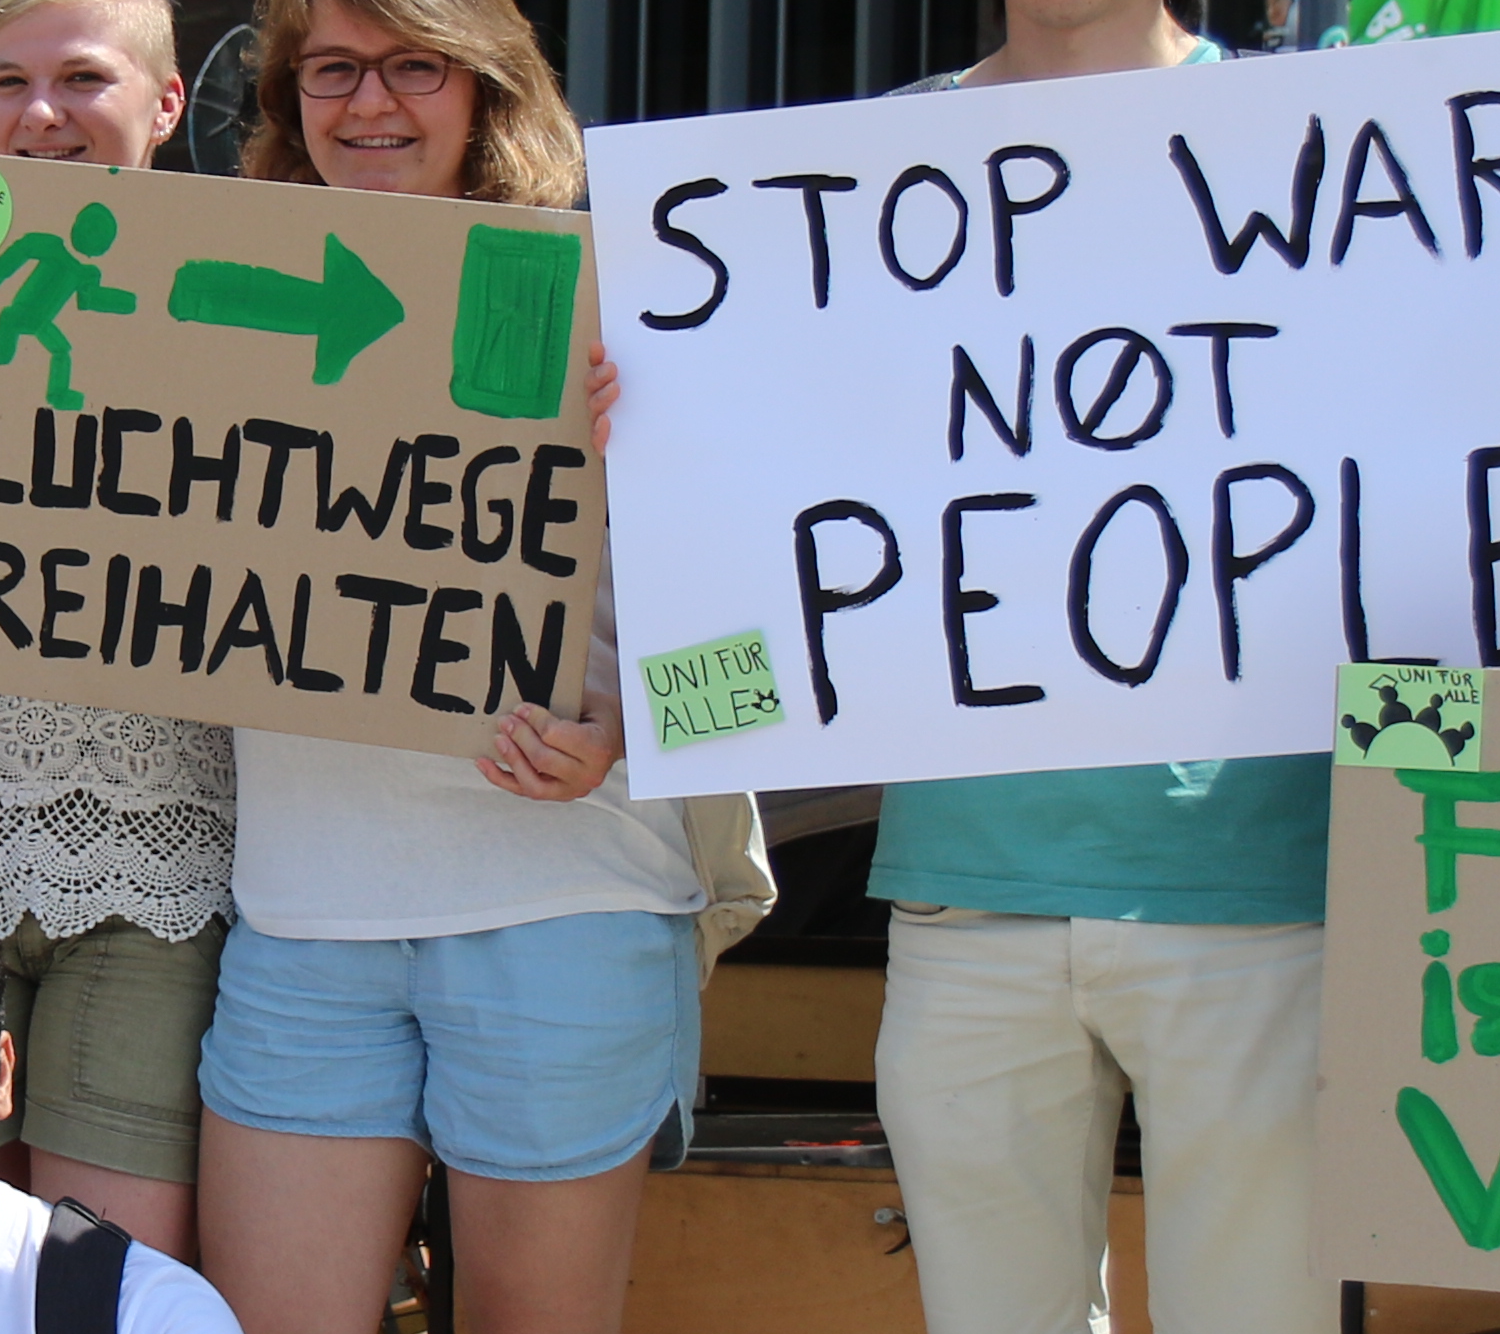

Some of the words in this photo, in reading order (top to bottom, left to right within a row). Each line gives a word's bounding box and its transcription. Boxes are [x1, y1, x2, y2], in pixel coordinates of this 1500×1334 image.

[640, 143, 1071, 330] STOP
[647, 654, 708, 697] UNI
[714, 642, 769, 680] FÜR
[1398, 669, 1432, 684] UNI
[1435, 670, 1473, 688] FÜR
[1444, 689, 1480, 704] ALLE
[663, 689, 757, 744] ALLE
